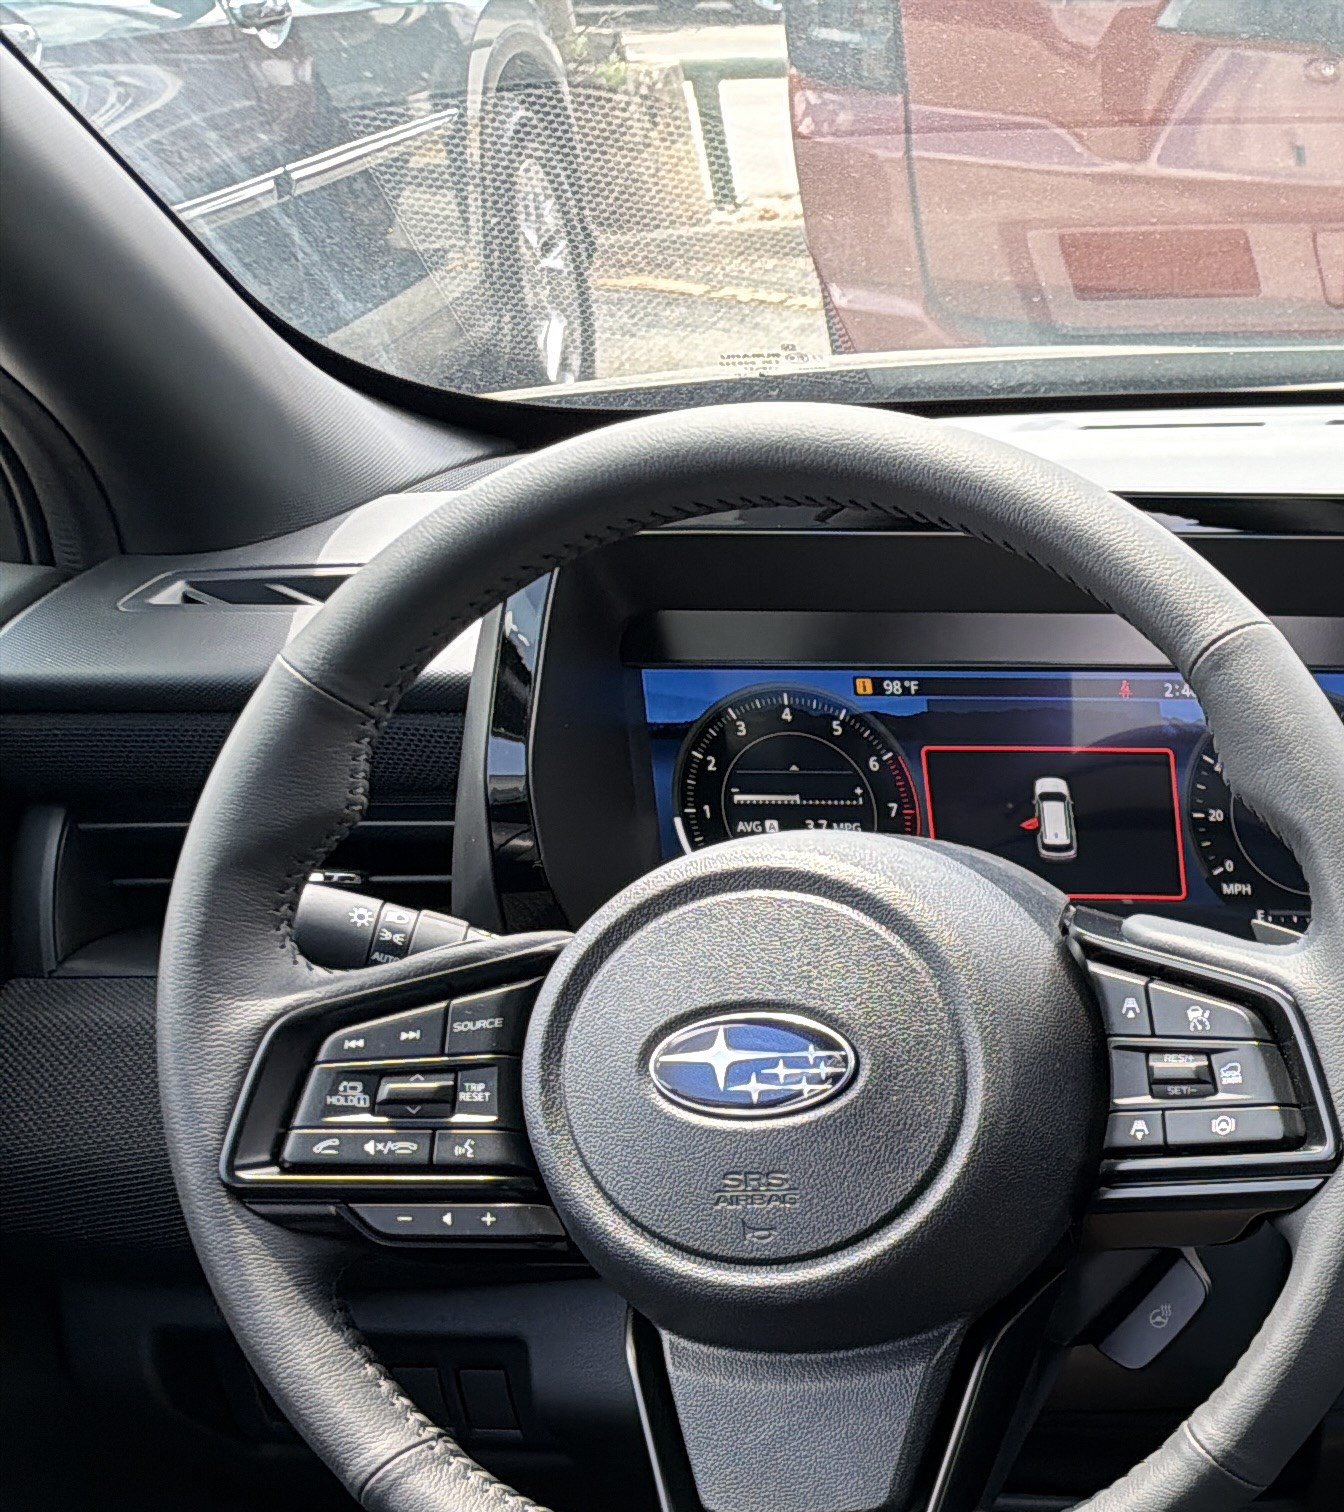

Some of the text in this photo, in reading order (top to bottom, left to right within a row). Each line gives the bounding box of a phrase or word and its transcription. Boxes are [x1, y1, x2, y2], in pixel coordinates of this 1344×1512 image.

[882, 680, 920, 696] 98°F
[1164, 683, 1197, 698] 2:4
[781, 708, 792, 723] 4
[736, 721, 747, 737] 3
[832, 720, 843, 736] 5
[707, 756, 717, 772] 2
[869, 756, 880, 772] 6
[703, 804, 711, 819] 1
[887, 802, 899, 818] 7
[1208, 809, 1224, 822] 20
[736, 820, 763, 833] AVG
[805, 819, 829, 831] 37
[1224, 861, 1234, 872] 0
[1222, 883, 1252, 896] MPH
[452, 1017, 504, 1033] SOURCE
[463, 1082, 486, 1092] TRIP
[458, 1092, 491, 1102] RESET
[722, 1171, 789, 1190] SRS
[712, 1194, 800, 1208] AIRBAG
